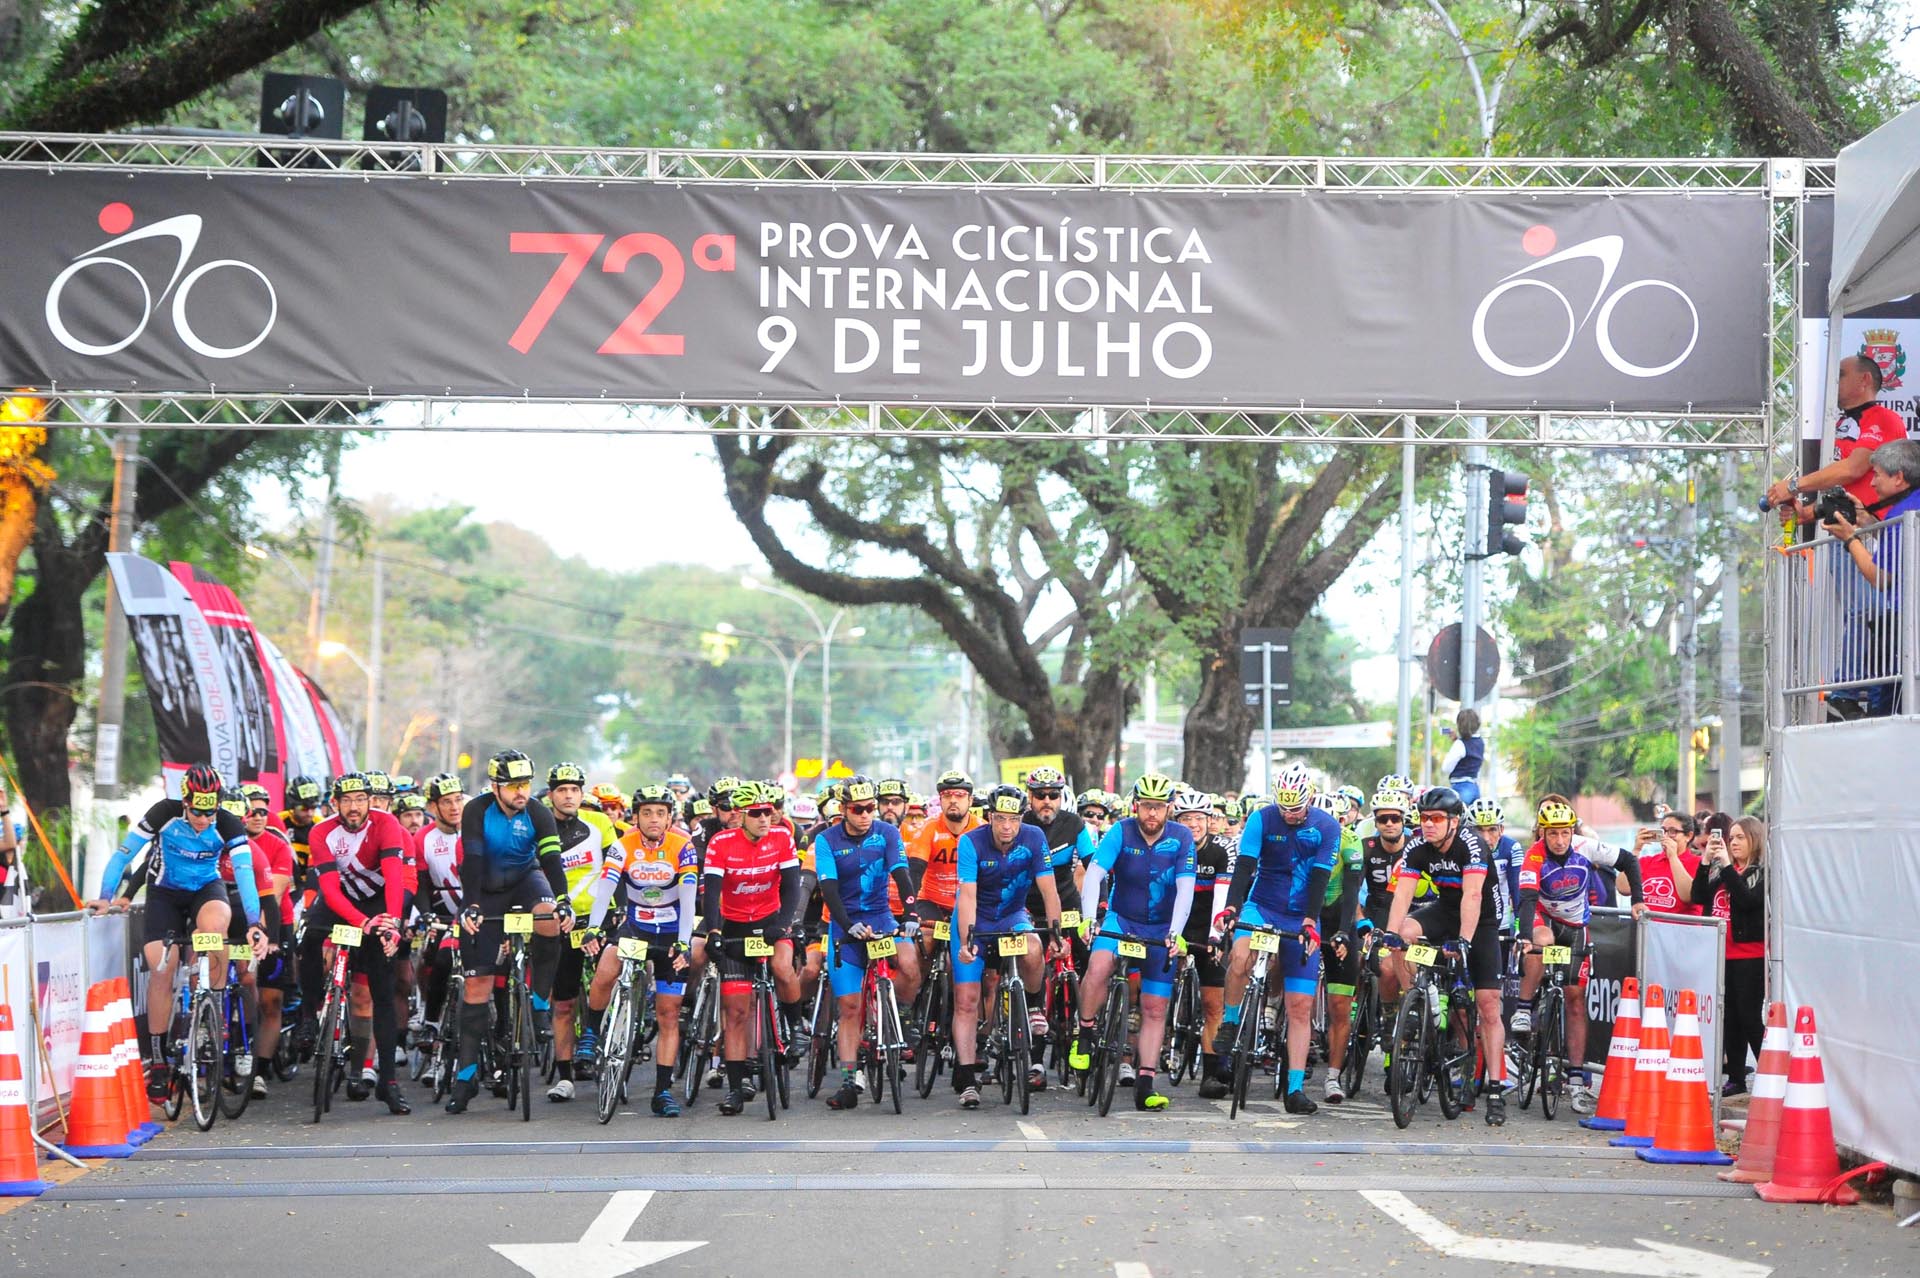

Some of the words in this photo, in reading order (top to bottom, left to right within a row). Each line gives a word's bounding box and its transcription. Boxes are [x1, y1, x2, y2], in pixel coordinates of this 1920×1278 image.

[760, 222, 930, 260] PROVA
[952, 216, 1213, 264] CICLÍSTICA
[507, 232, 736, 356] 72ª
[760, 266, 1213, 314] INTERNACIONAL
[757, 316, 798, 373] 9
[834, 318, 921, 375] DE
[961, 320, 1213, 379] JULHO
[517, 763, 523, 772] 7
[344, 780, 362, 790] 123
[195, 795, 215, 807] 230
[1279, 792, 1297, 803] 137
[999, 799, 1018, 810] 138
[1480, 814, 1492, 823] 79
[1553, 810, 1565, 819] 47
[631, 869, 671, 880] Conde
[727, 862, 779, 876] TREK
[515, 916, 522, 926] 7
[338, 927, 359, 940] 123
[197, 935, 218, 944] 230
[1003, 938, 1023, 949] 138
[1256, 934, 1275, 945] 137
[631, 942, 637, 951] 5
[872, 940, 891, 952] 140
[1122, 944, 1142, 953] 139
[1414, 948, 1429, 958] 97
[1550, 948, 1562, 958] 47
